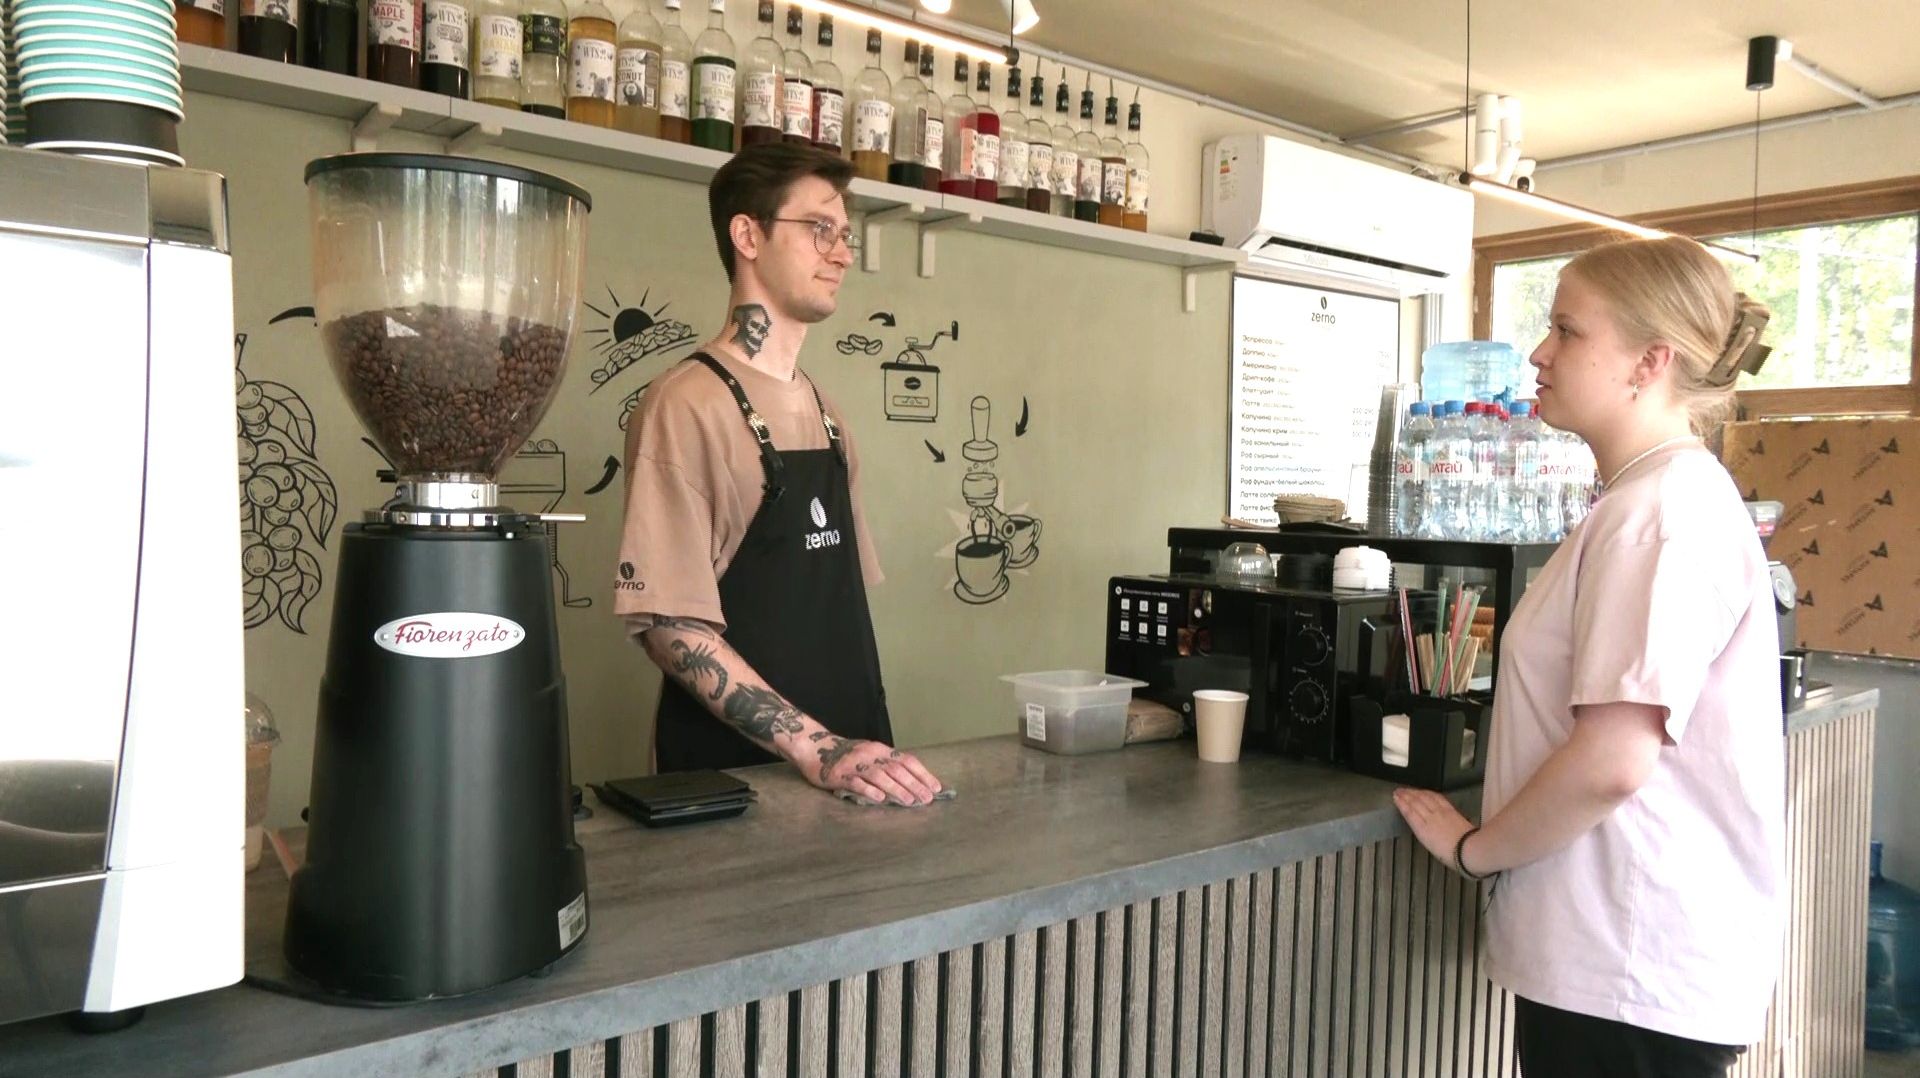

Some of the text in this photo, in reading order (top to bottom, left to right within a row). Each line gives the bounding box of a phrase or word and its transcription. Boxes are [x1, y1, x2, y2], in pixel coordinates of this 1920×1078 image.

[1311, 312, 1336, 325] zerno
[1242, 334, 1273, 345] Эспрессо
[1242, 347, 1266, 357] Доппио
[1242, 360, 1277, 371] Американо
[1241, 398, 1260, 407] Латте
[1241, 412, 1272, 421] Капучино
[1241, 425, 1272, 433] Капучино
[804, 529, 841, 550] zerno
[614, 579, 646, 591] erno
[394, 621, 511, 652] Fiorenzato
